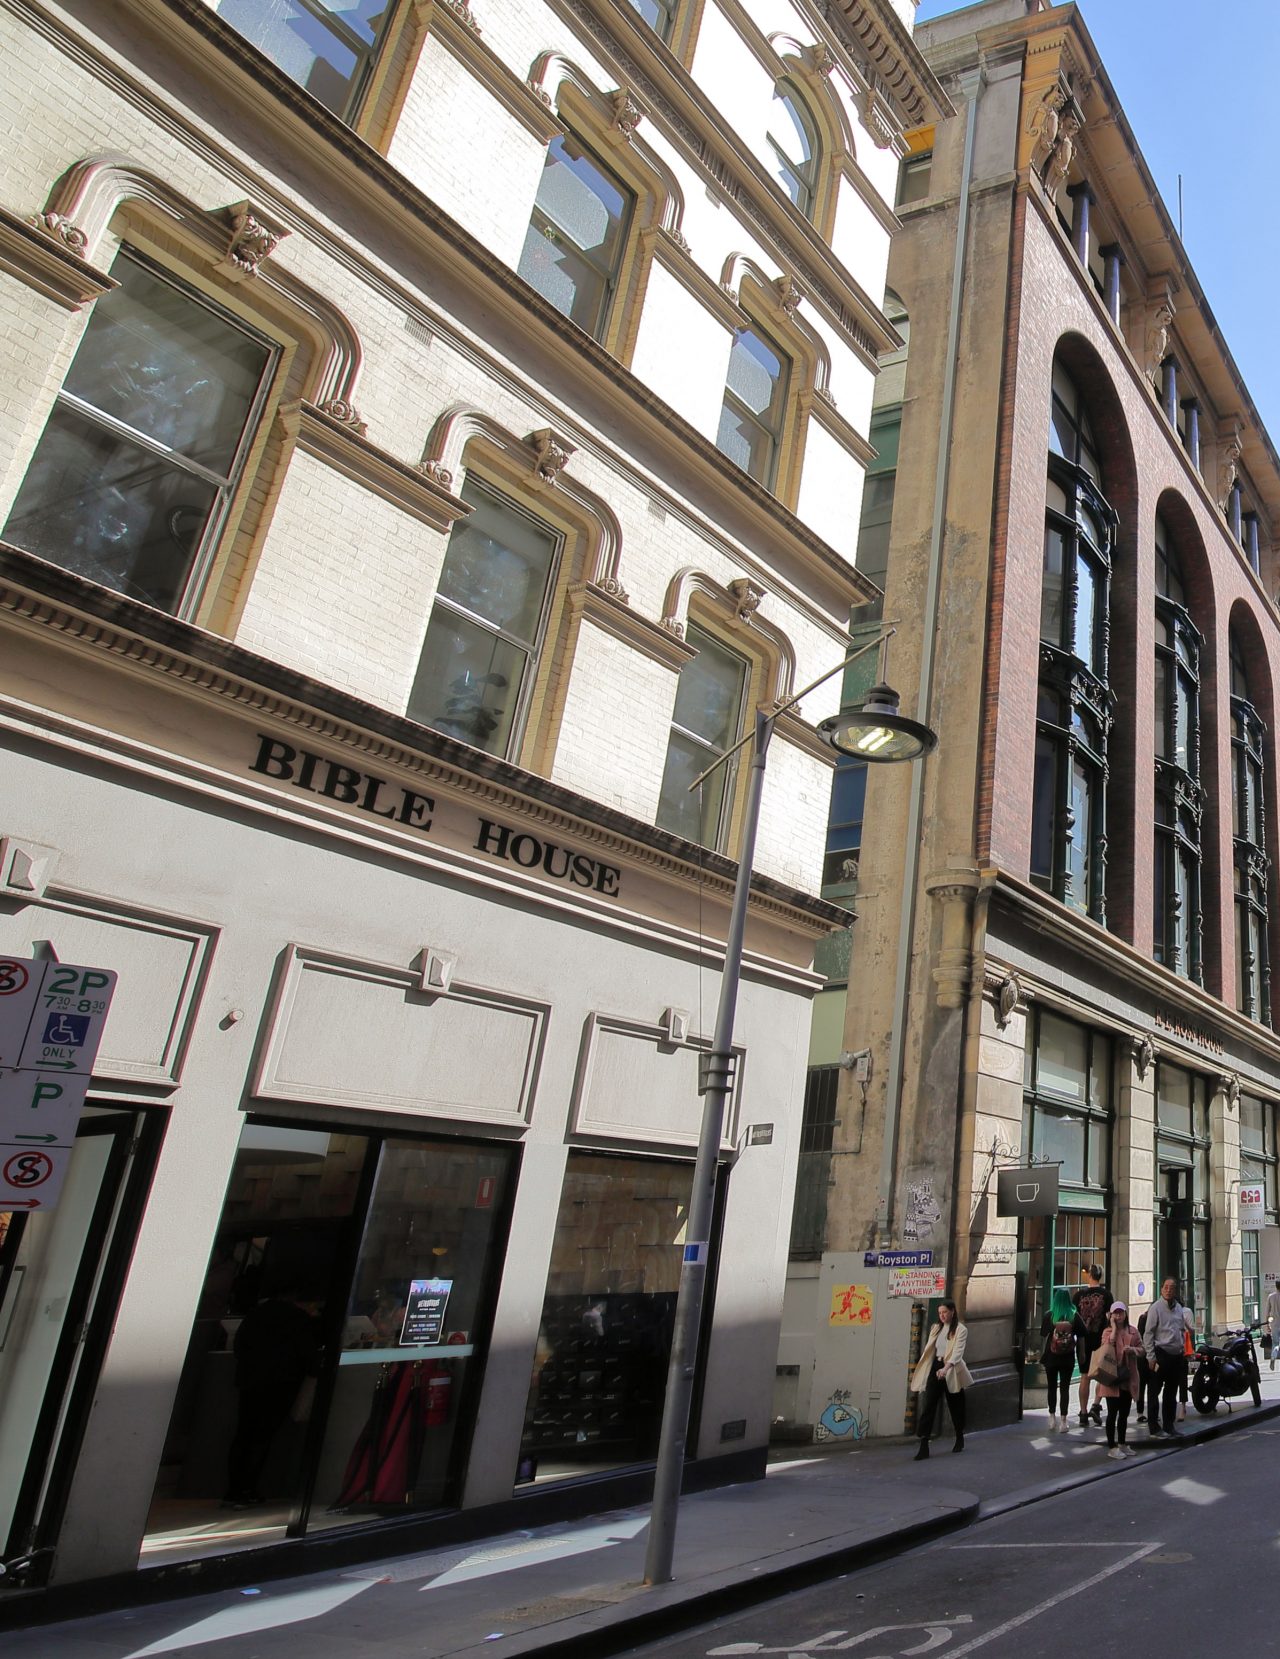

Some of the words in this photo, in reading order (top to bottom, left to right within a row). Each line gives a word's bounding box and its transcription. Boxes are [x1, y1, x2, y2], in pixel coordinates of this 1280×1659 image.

[247, 732, 436, 833] BIBLE
[472, 816, 622, 898] HOUSE
[48, 968, 110, 996] 2P
[42, 1046, 76, 1059] ONLY
[31, 1082, 63, 1109] P
[877, 1254, 918, 1267] Royston
[920, 1253, 930, 1264] Pl
[905, 1271, 941, 1279] STANDING
[900, 1279, 932, 1287] ANYTIME
[903, 1287, 935, 1295] LANEWA
